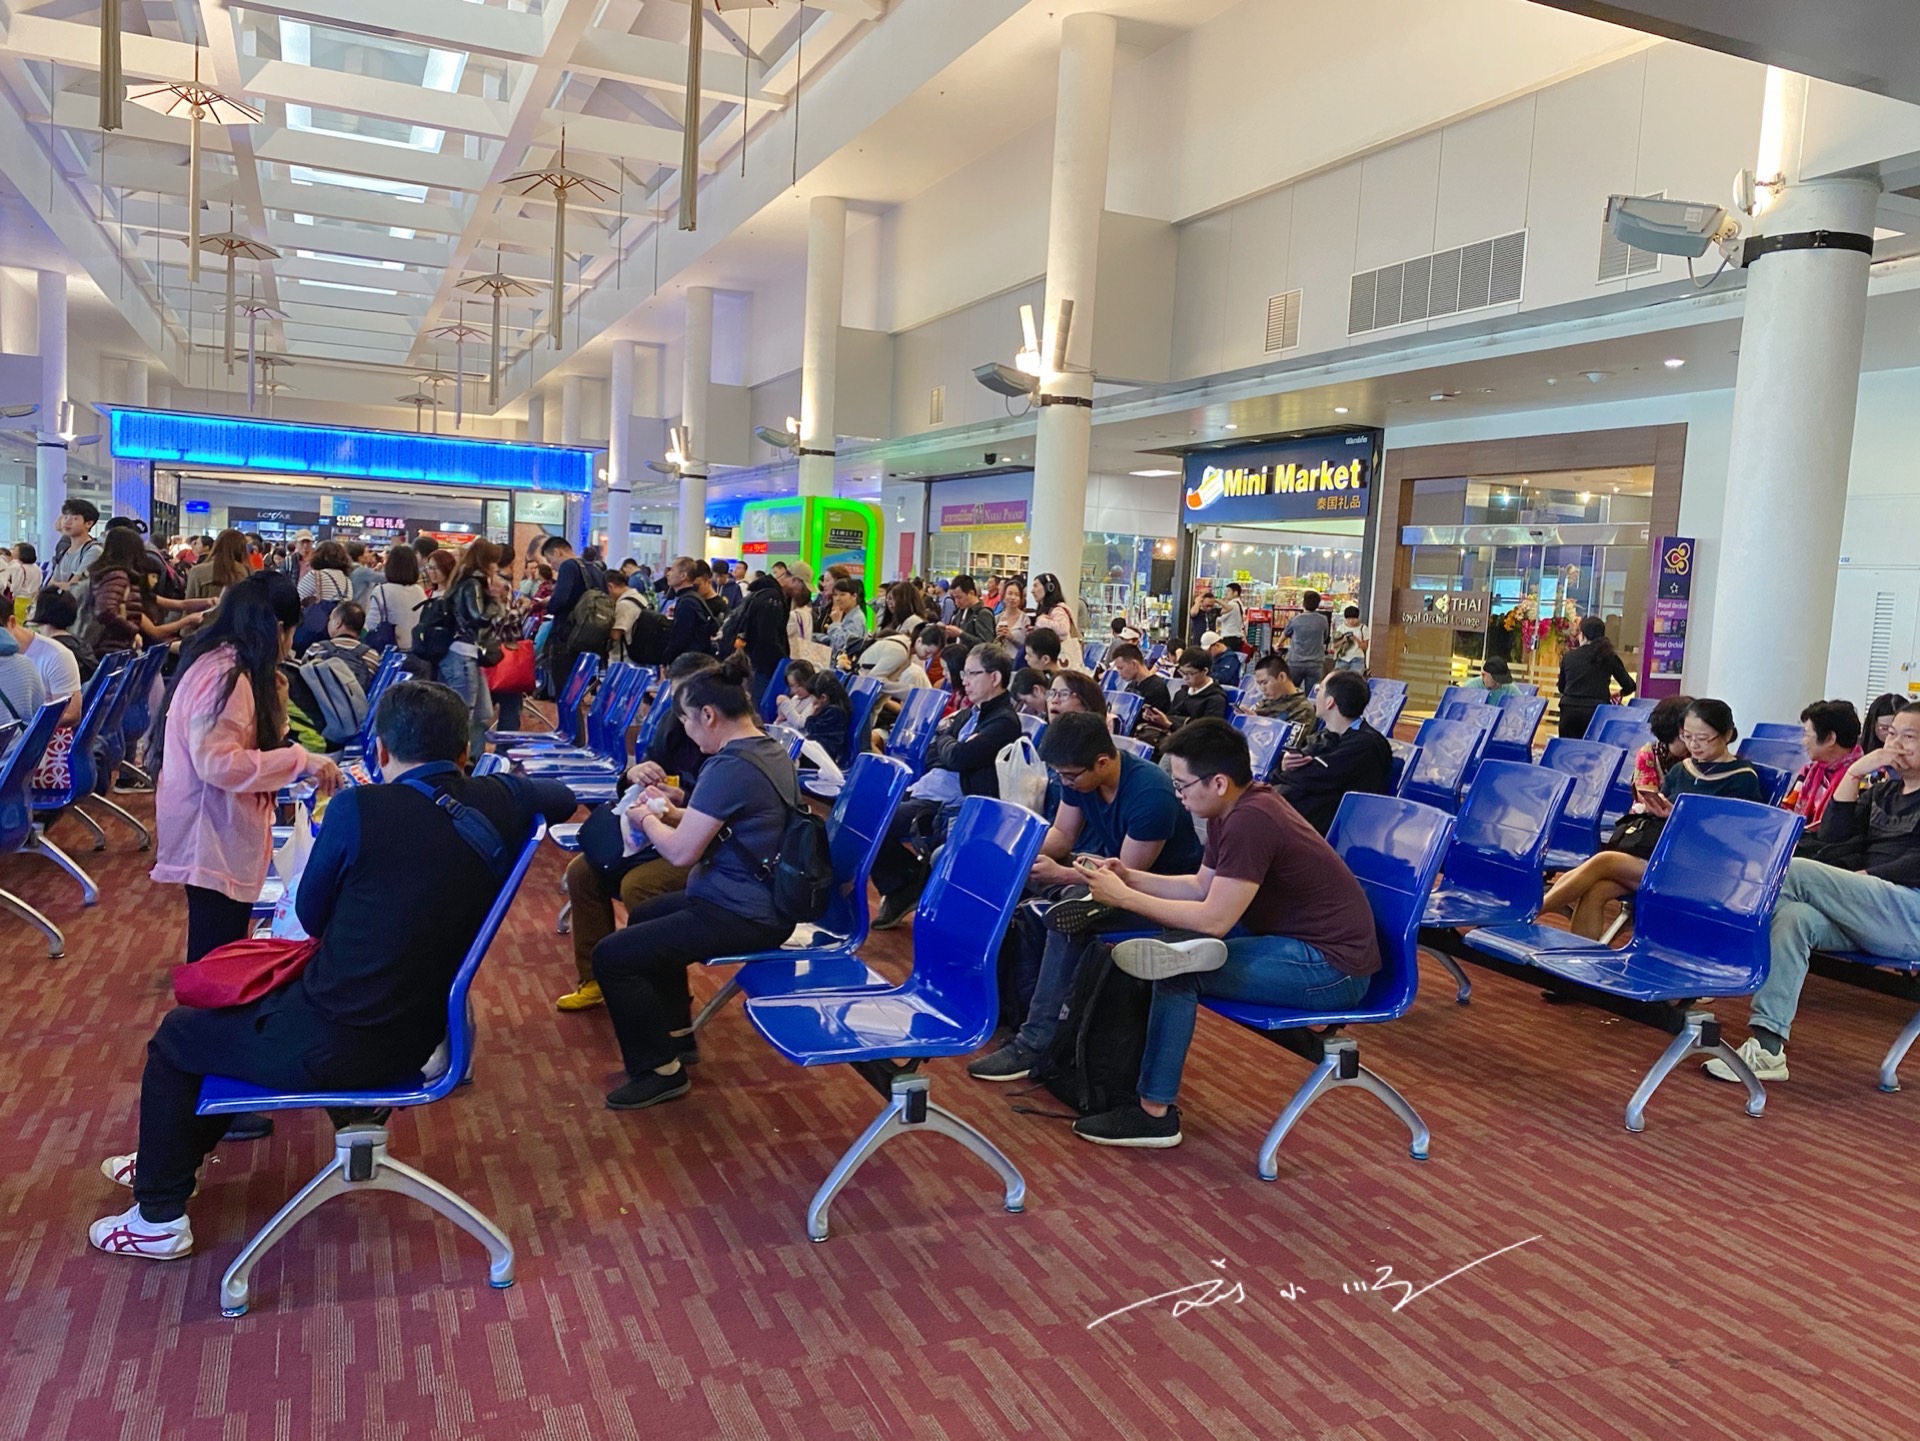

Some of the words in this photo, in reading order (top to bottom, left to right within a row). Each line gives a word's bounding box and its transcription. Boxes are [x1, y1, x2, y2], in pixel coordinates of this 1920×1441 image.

[1223, 465, 1269, 498] Mini
[1274, 458, 1362, 494] Market
[1316, 495, 1361, 511] 泰国礼品
[365, 517, 405, 529] 泰国礼品
[1664, 567, 1677, 575] THAI
[1451, 597, 1482, 612] THAI
[1658, 602, 1671, 610] Royal
[1672, 602, 1688, 610] Orchid
[1423, 613, 1449, 625] Orchid
[1451, 615, 1480, 628] Lounge
[1654, 641, 1667, 649] Royal
[1668, 641, 1684, 649] Orchid
[1653, 649, 1671, 657] Lounge
